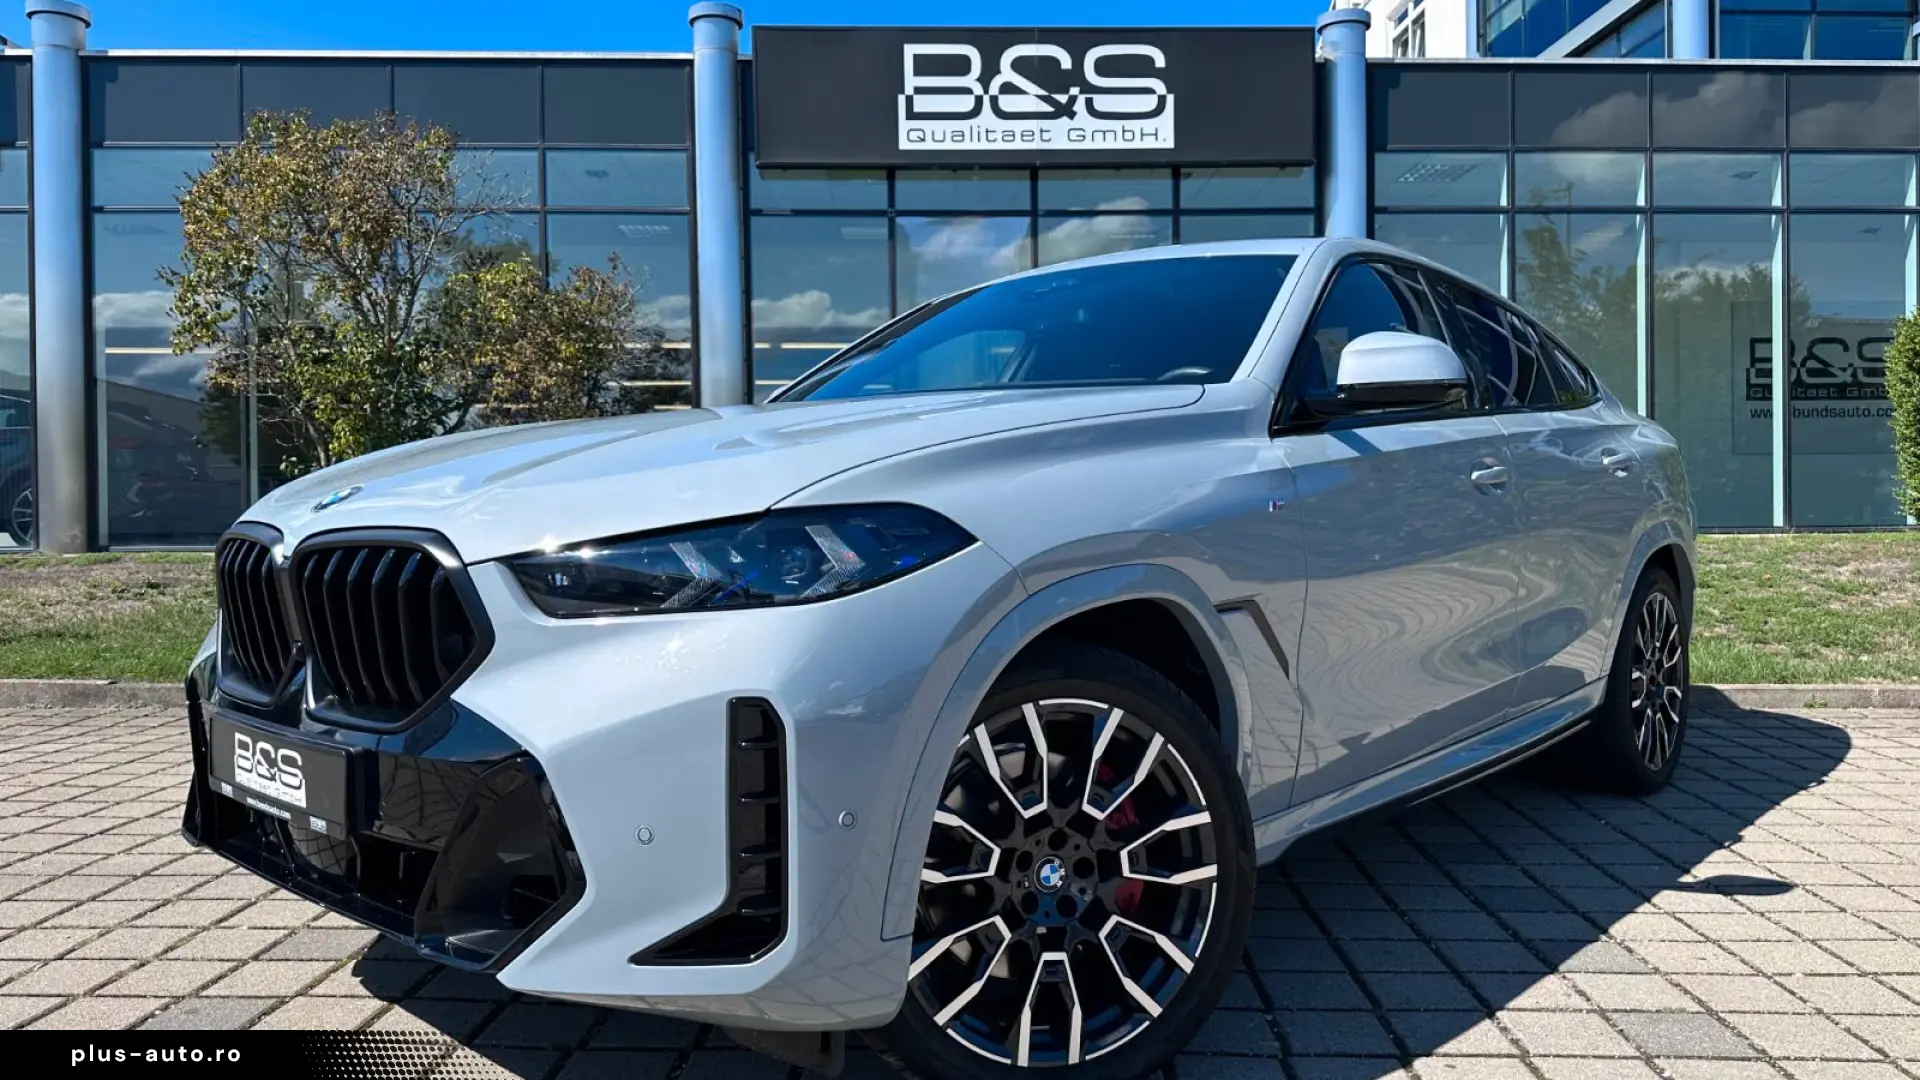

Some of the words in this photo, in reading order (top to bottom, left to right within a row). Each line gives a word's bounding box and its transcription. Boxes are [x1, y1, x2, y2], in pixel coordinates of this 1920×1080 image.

[903, 43, 1168, 121] B&S
[906, 125, 1052, 144] Qualitaet
[1066, 125, 1168, 143] GmbH.
[234, 731, 304, 791] B&S
